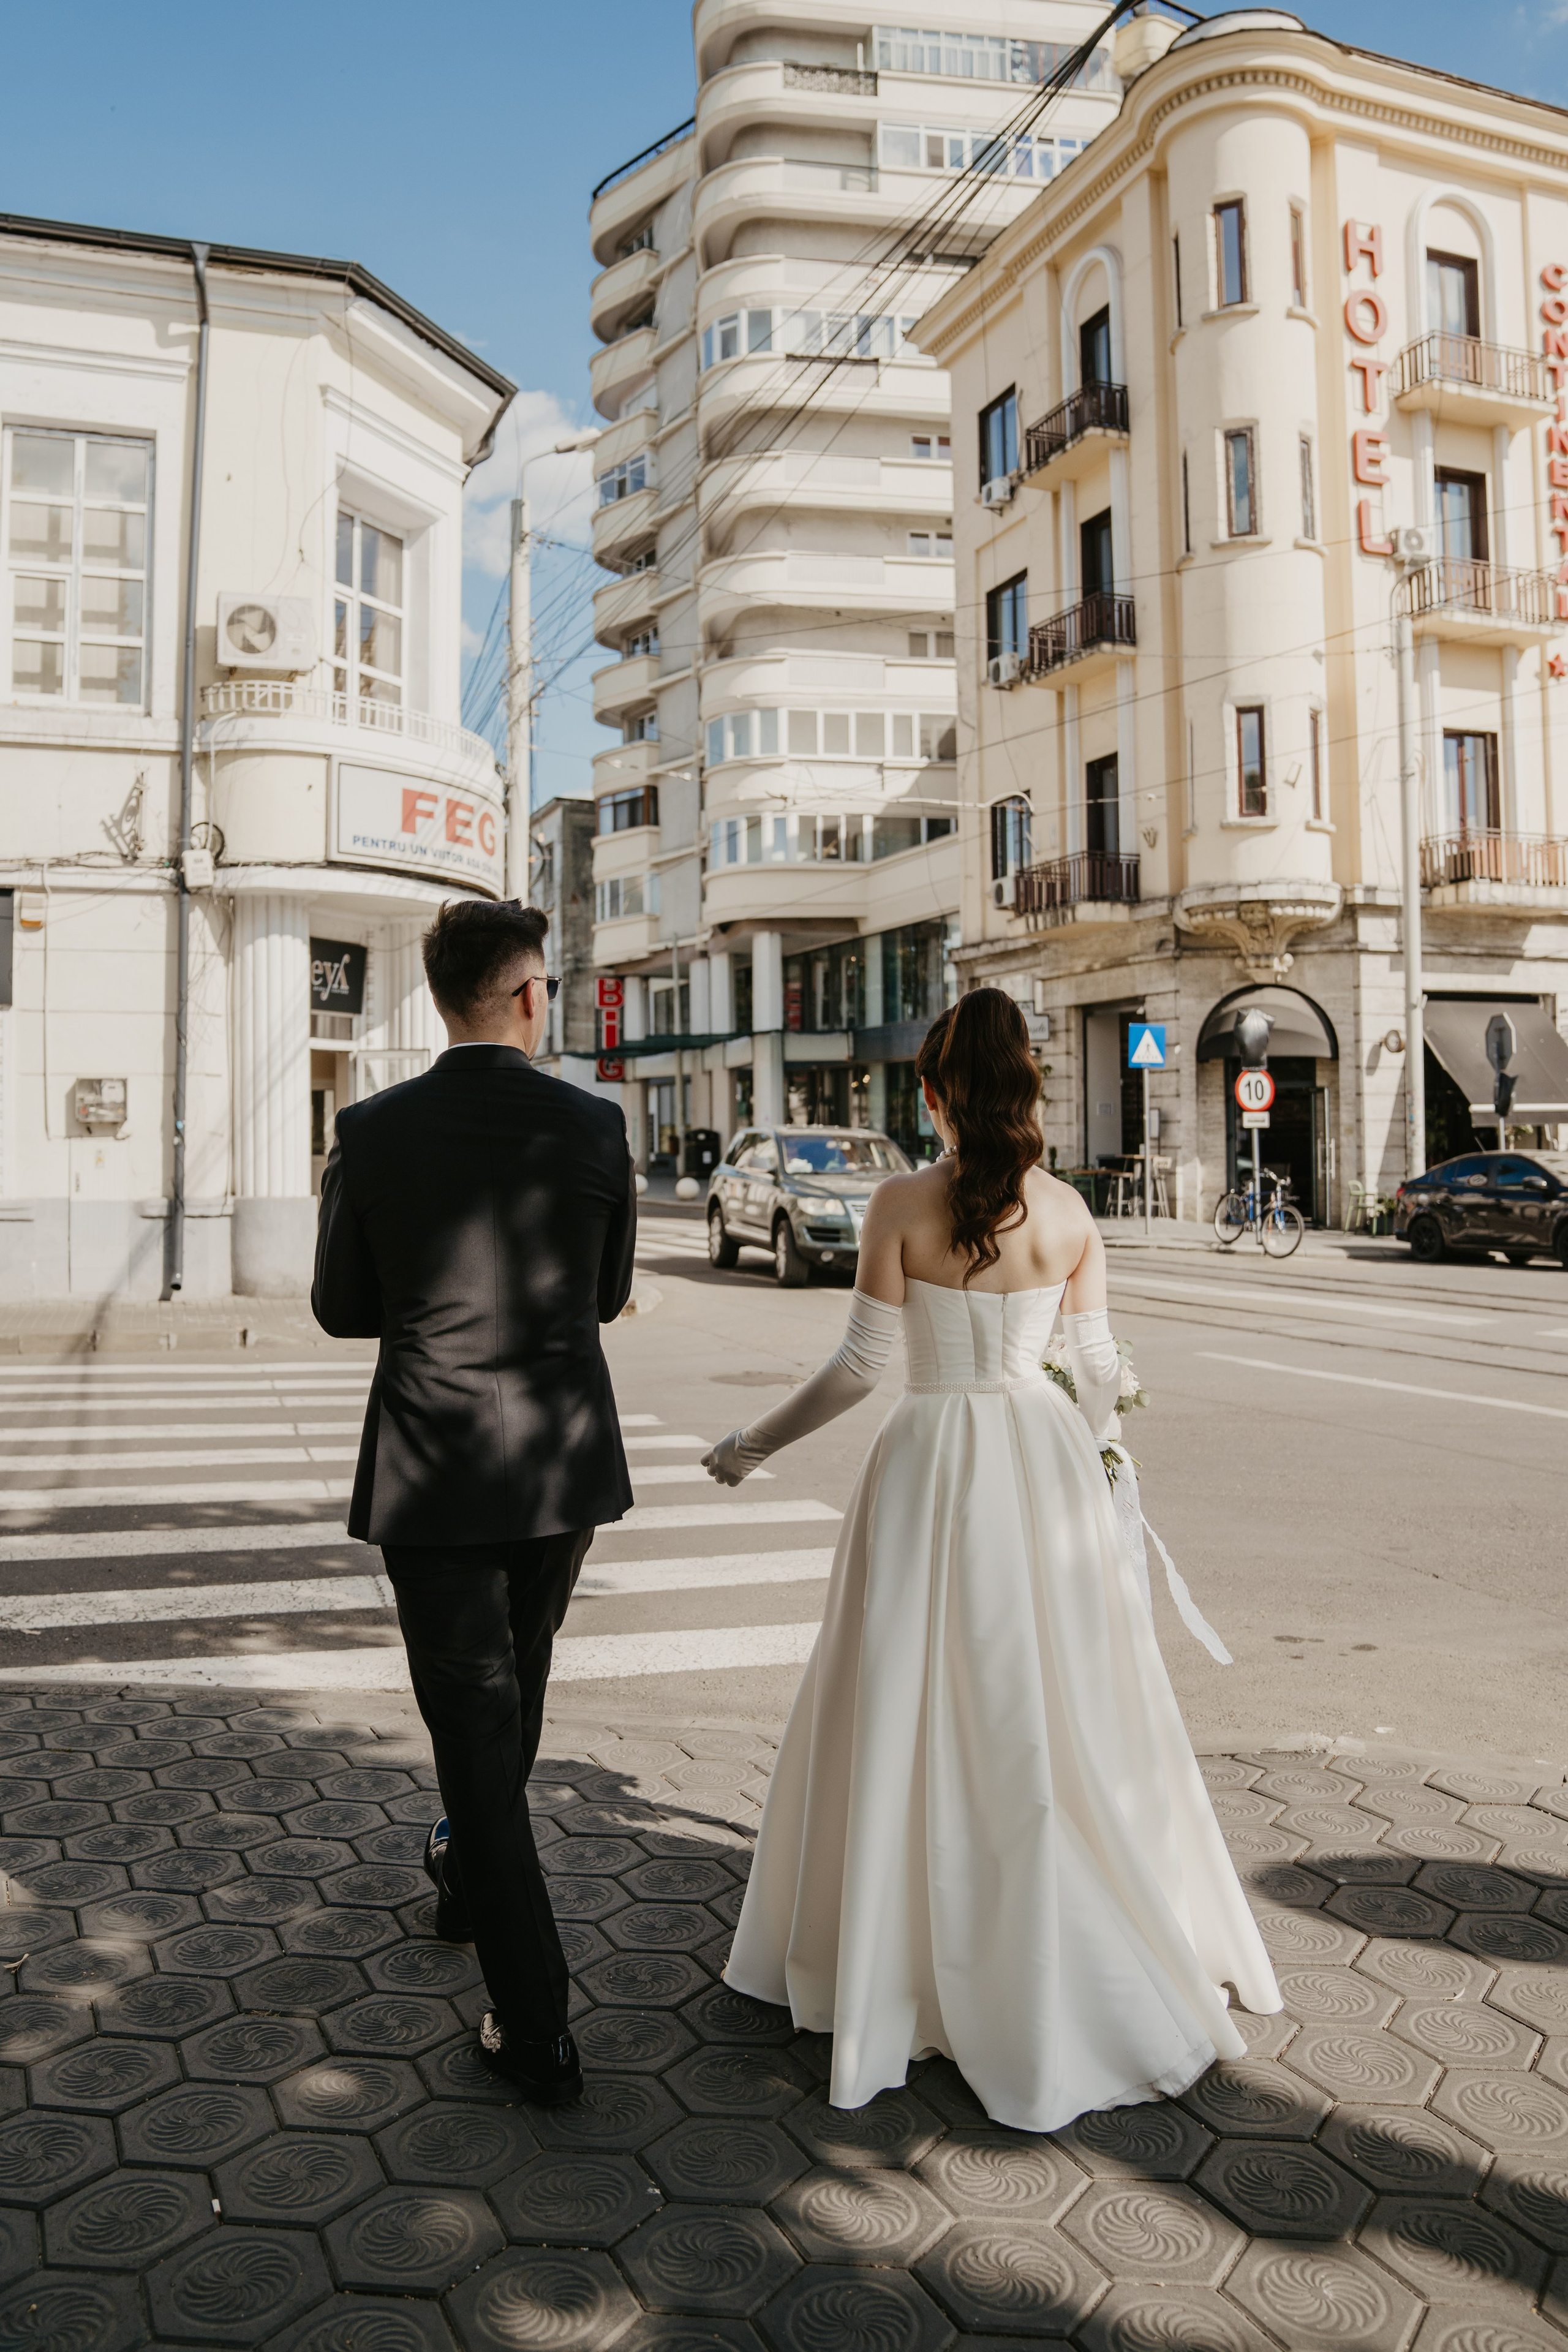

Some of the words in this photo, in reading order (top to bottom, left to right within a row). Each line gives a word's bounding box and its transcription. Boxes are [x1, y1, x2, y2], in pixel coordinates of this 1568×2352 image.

[1343, 218, 1393, 555] HOTEL
[401, 788, 496, 856] FEG
[352, 835, 406, 853] PENTRU
[410, 844, 427, 856] UN
[1245, 1080, 1264, 1100] 10
